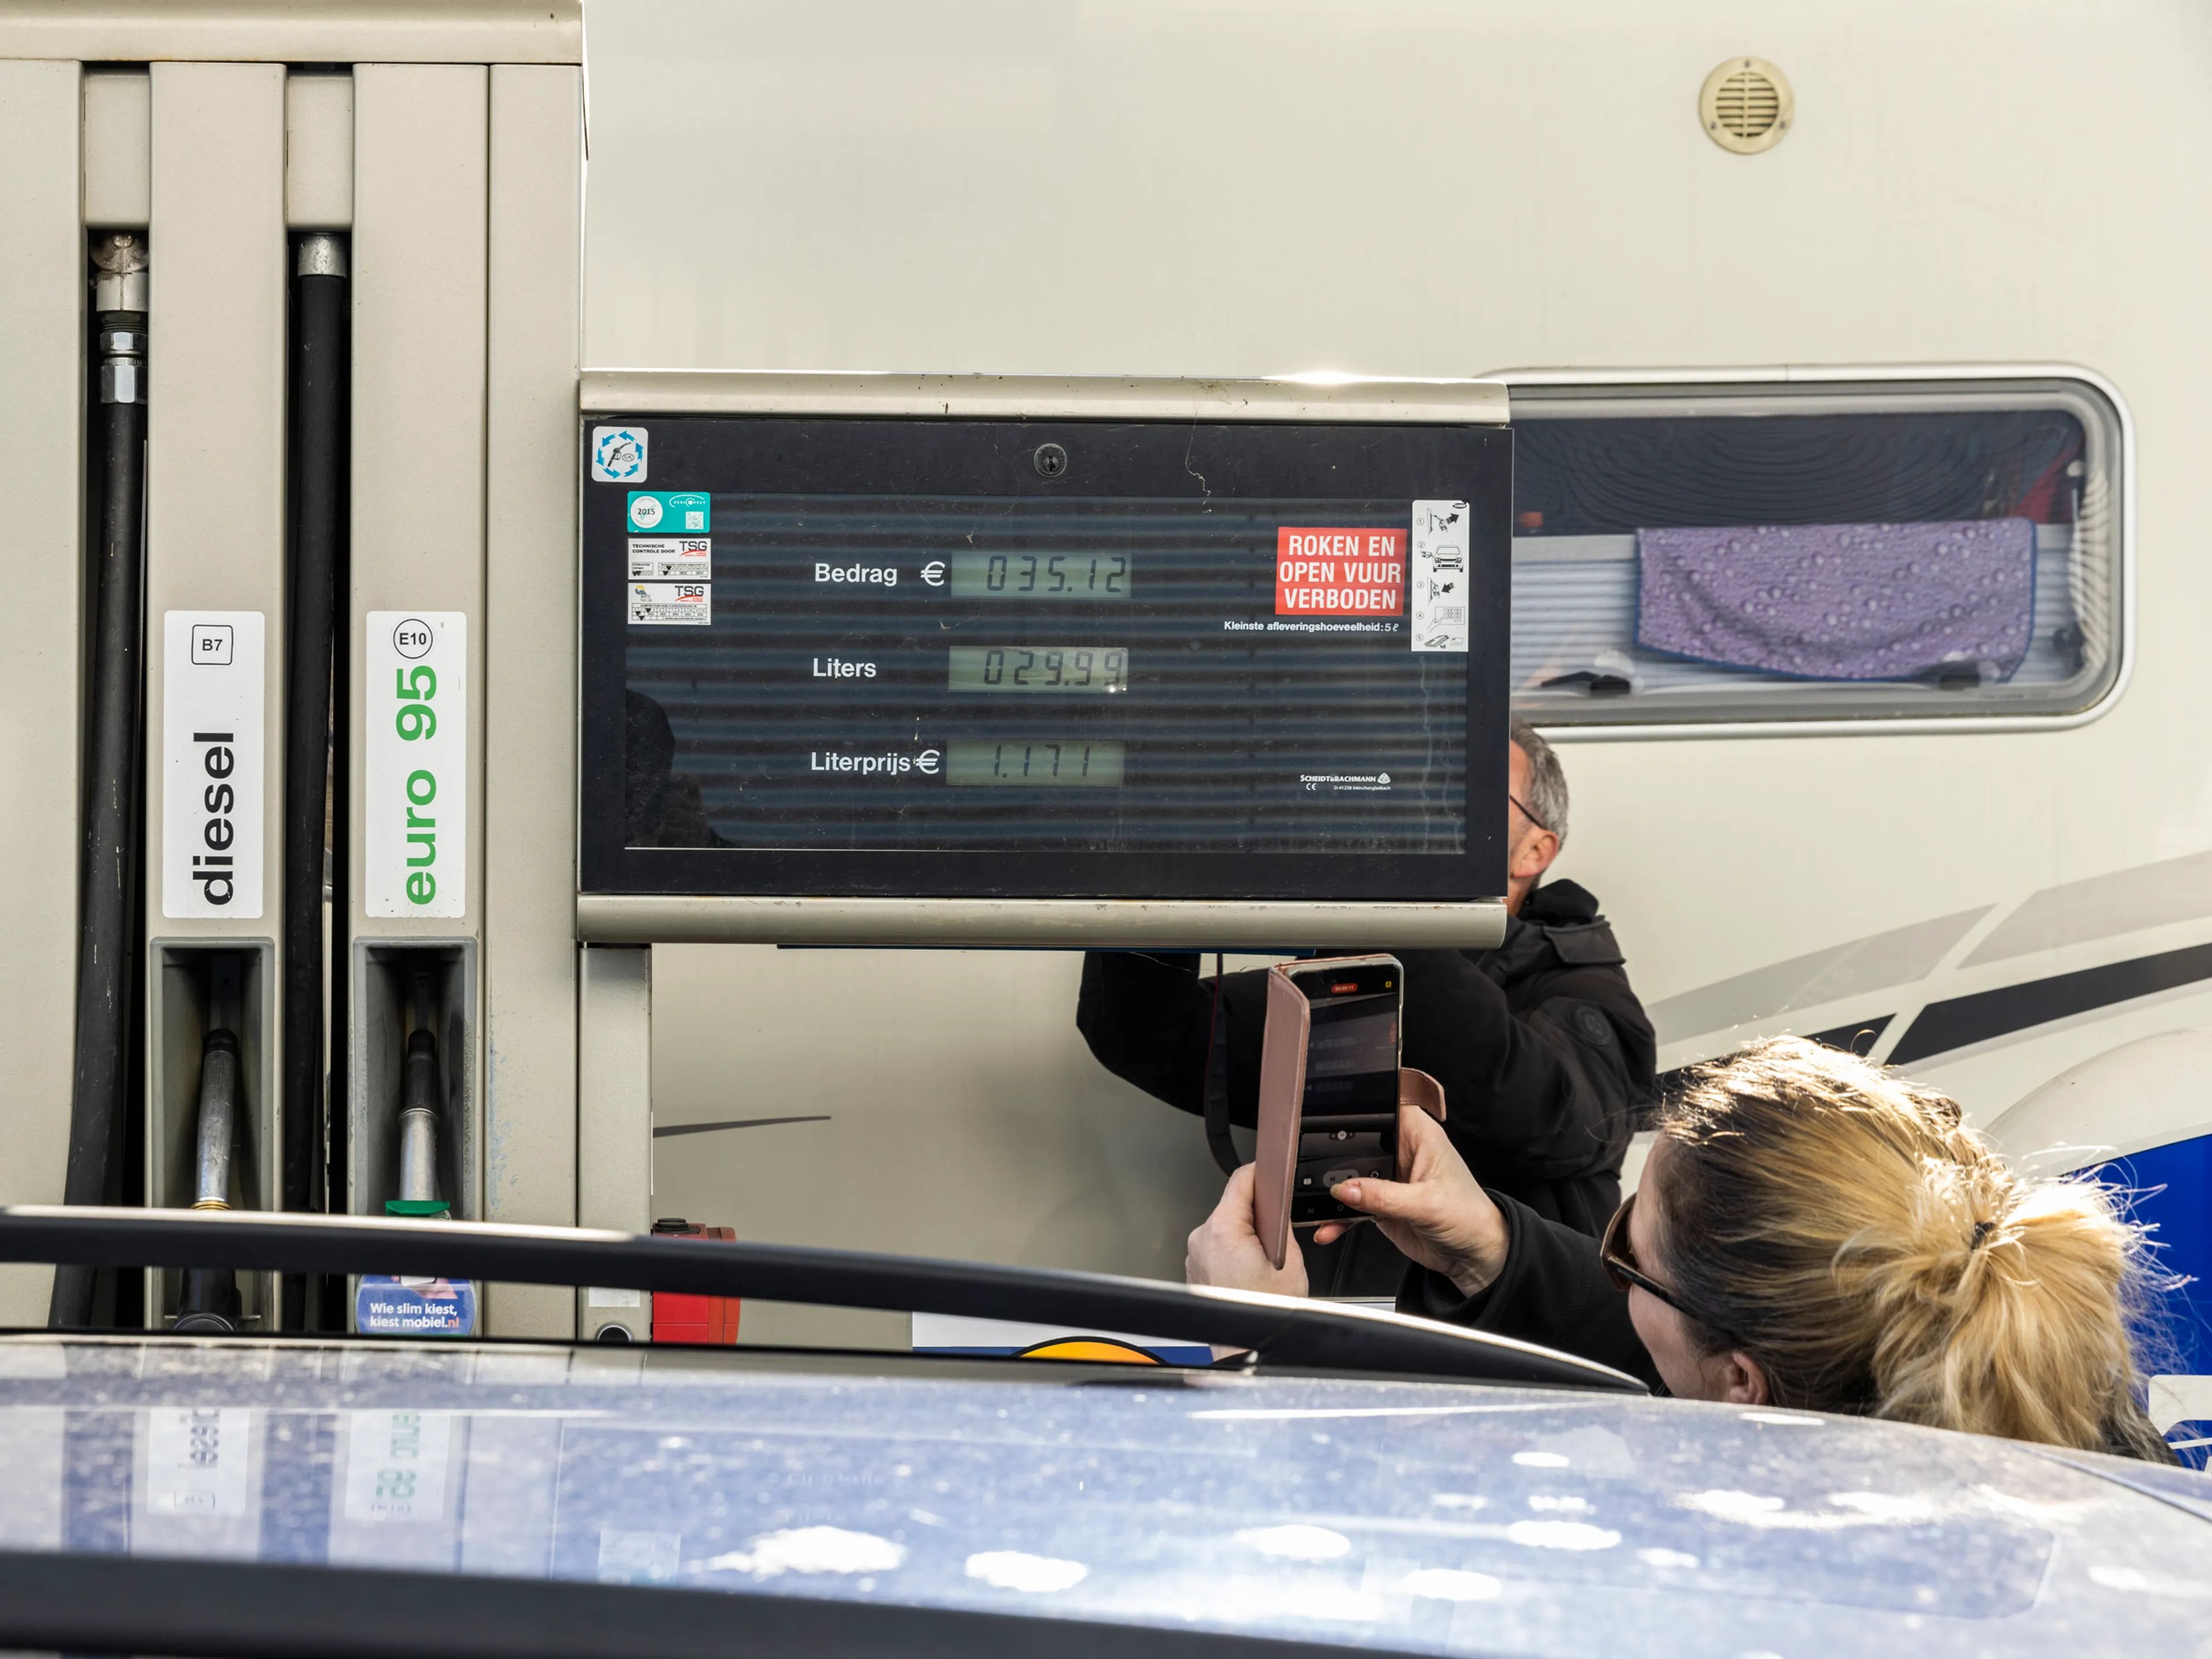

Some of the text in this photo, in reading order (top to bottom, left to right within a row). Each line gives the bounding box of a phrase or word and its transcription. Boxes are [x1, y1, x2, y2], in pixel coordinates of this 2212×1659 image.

[679, 541, 707, 551] TSG
[1289, 535, 1395, 556] ROKEN EN
[815, 560, 946, 587] Bedrag €
[986, 555, 1126, 592] 035.12
[1279, 562, 1401, 584] OPEN VUUR
[675, 585, 704, 596] TSG
[1285, 589, 1396, 609] VERBODEN
[1224, 621, 1264, 631] Kleinste
[202, 639, 223, 651] B7
[399, 633, 427, 645] E10
[813, 658, 877, 677] Liters
[984, 650, 1123, 686] 029.99
[811, 749, 940, 775] Literprijs €
[993, 744, 1090, 778] 1.171
[396, 665, 437, 905] euro 95
[192, 732, 234, 906] diesel
[370, 1302, 457, 1316] Wie slim kiest,
[370, 1317, 460, 1328] kiest mobiel.nl
